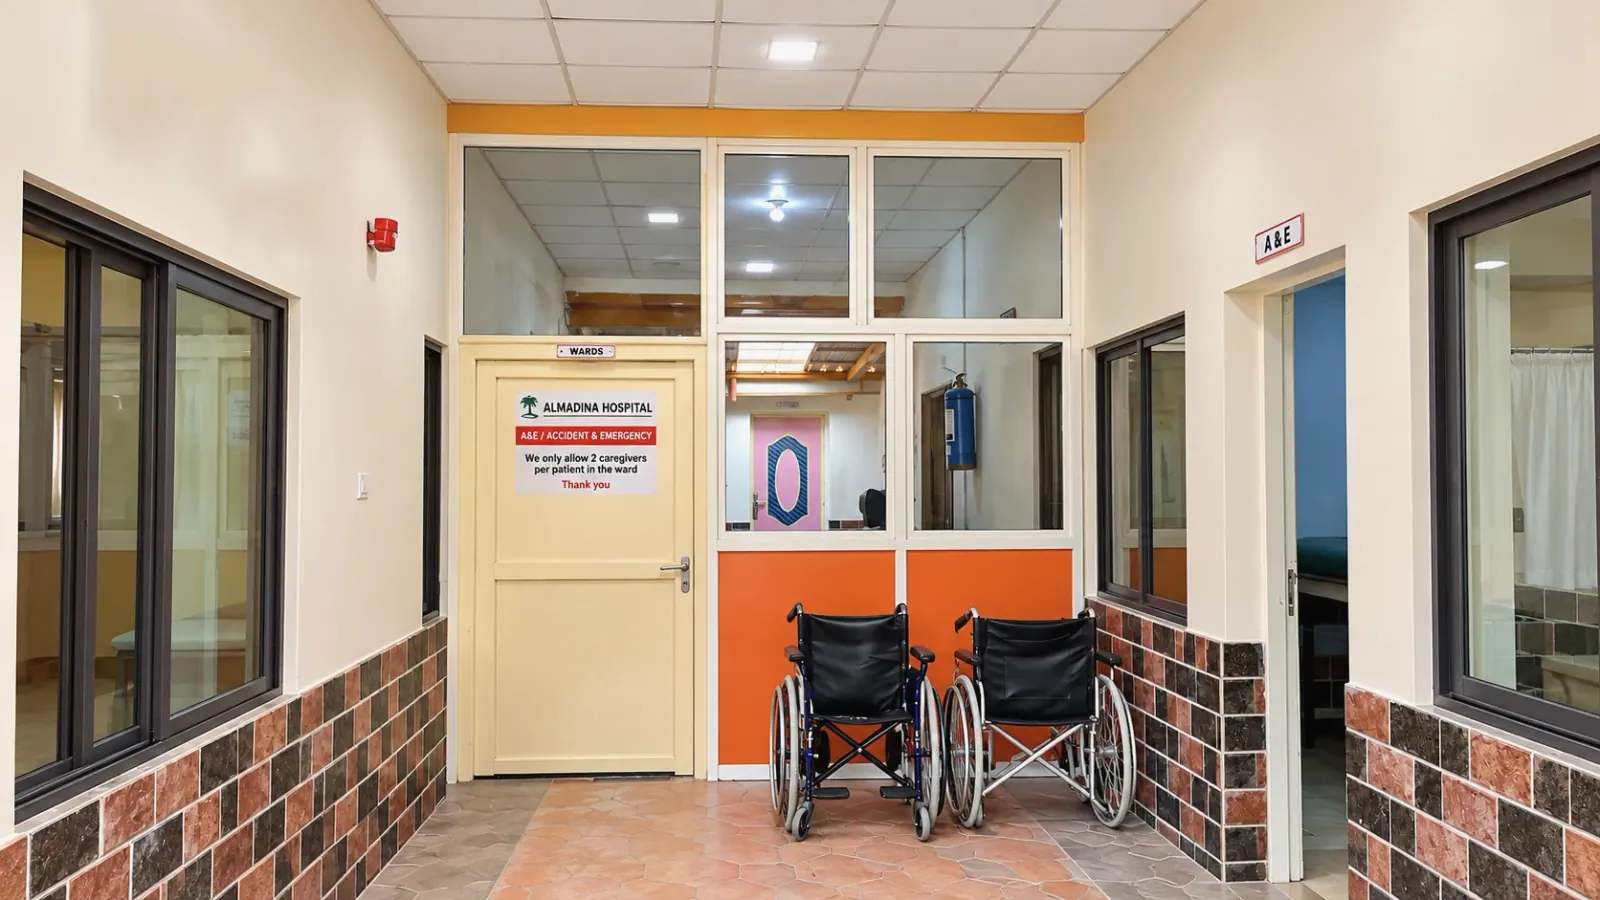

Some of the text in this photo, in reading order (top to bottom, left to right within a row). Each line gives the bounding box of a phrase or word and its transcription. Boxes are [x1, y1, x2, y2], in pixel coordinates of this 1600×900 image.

[1264, 225, 1291, 253] A&E
[570, 348, 603, 356] WARDS
[543, 402, 653, 413] ALMADINA HOSPITAL
[520, 431, 538, 440] A&E
[546, 431, 589, 440] ACCIDENT
[591, 431, 598, 440] &
[600, 431, 652, 440] EMERGENCY
[525, 453, 647, 465] We only allow 2 caregivers
[534, 464, 638, 475] per patient in the ward
[562, 480, 610, 490] Thank you
